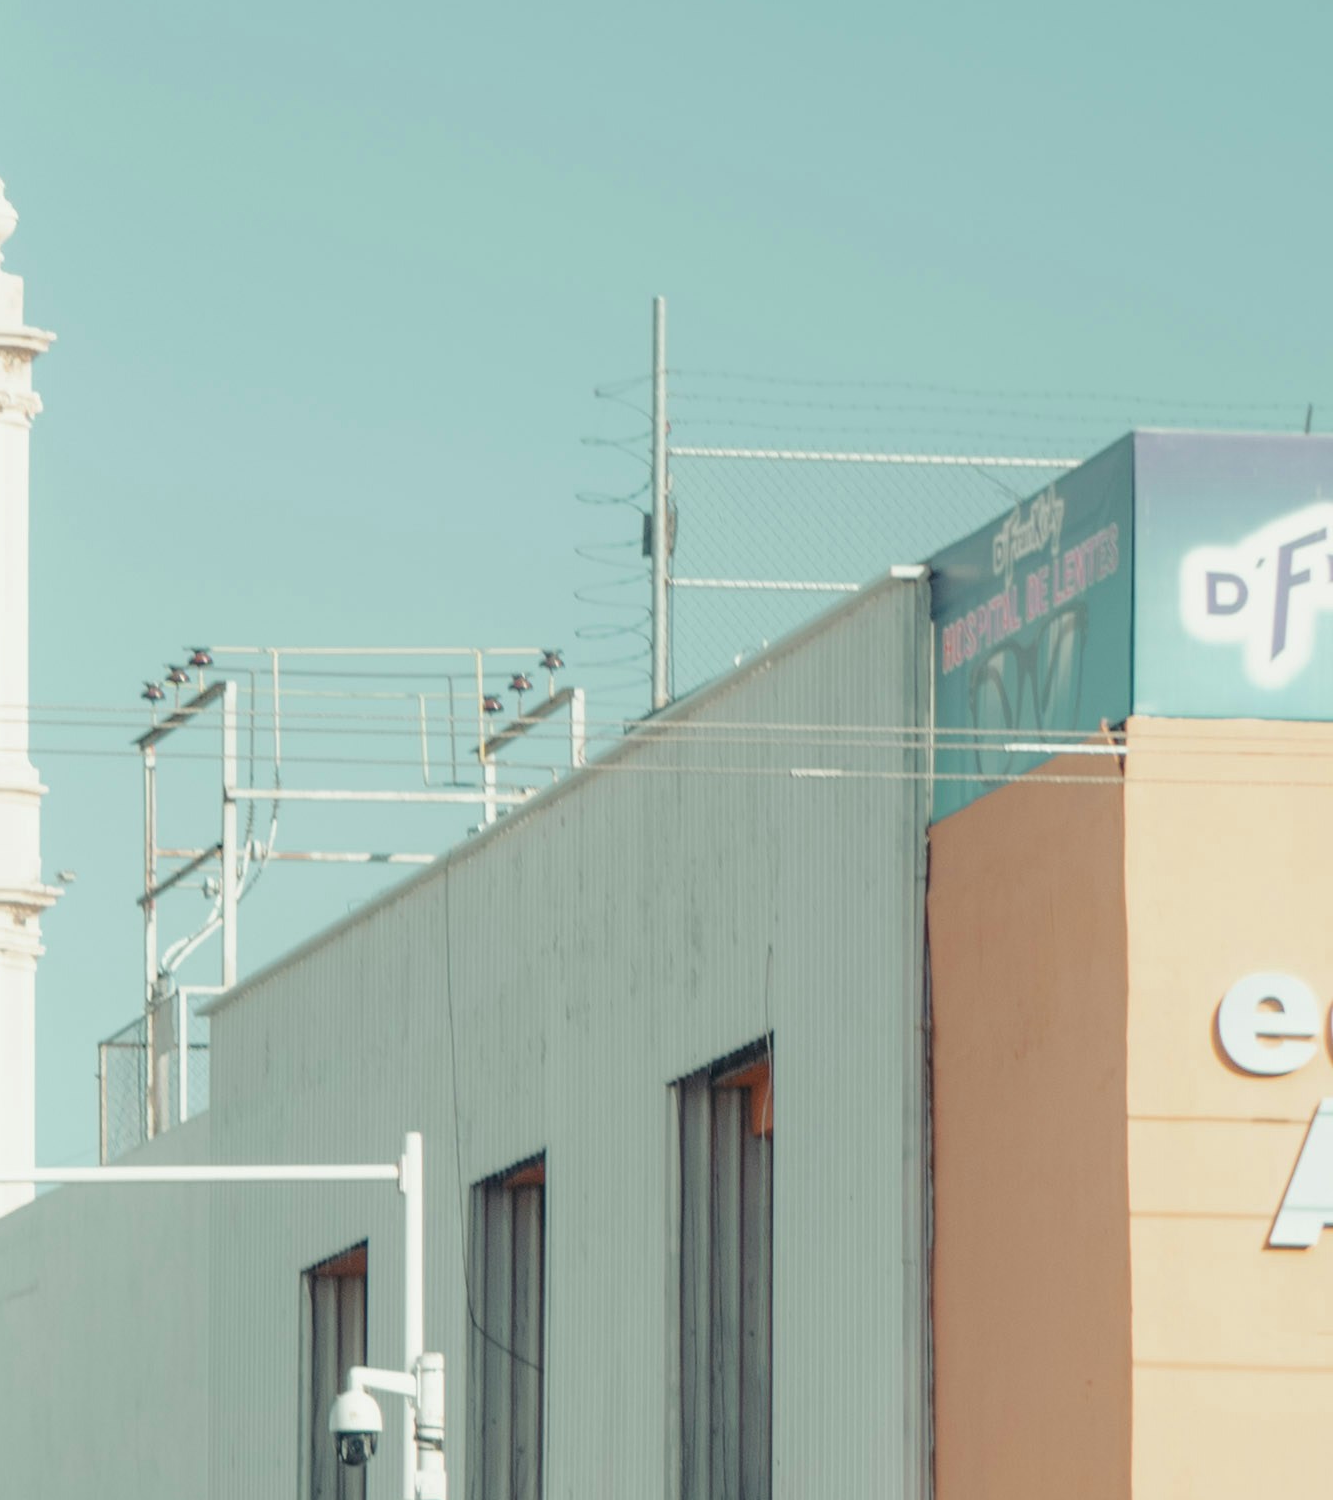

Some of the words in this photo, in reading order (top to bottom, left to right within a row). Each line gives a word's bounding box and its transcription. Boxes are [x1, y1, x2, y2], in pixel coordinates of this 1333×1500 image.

[943, 586, 1022, 674] HOSPITAL
[1026, 565, 1050, 623] DE
[1053, 522, 1119, 606] LENTES
